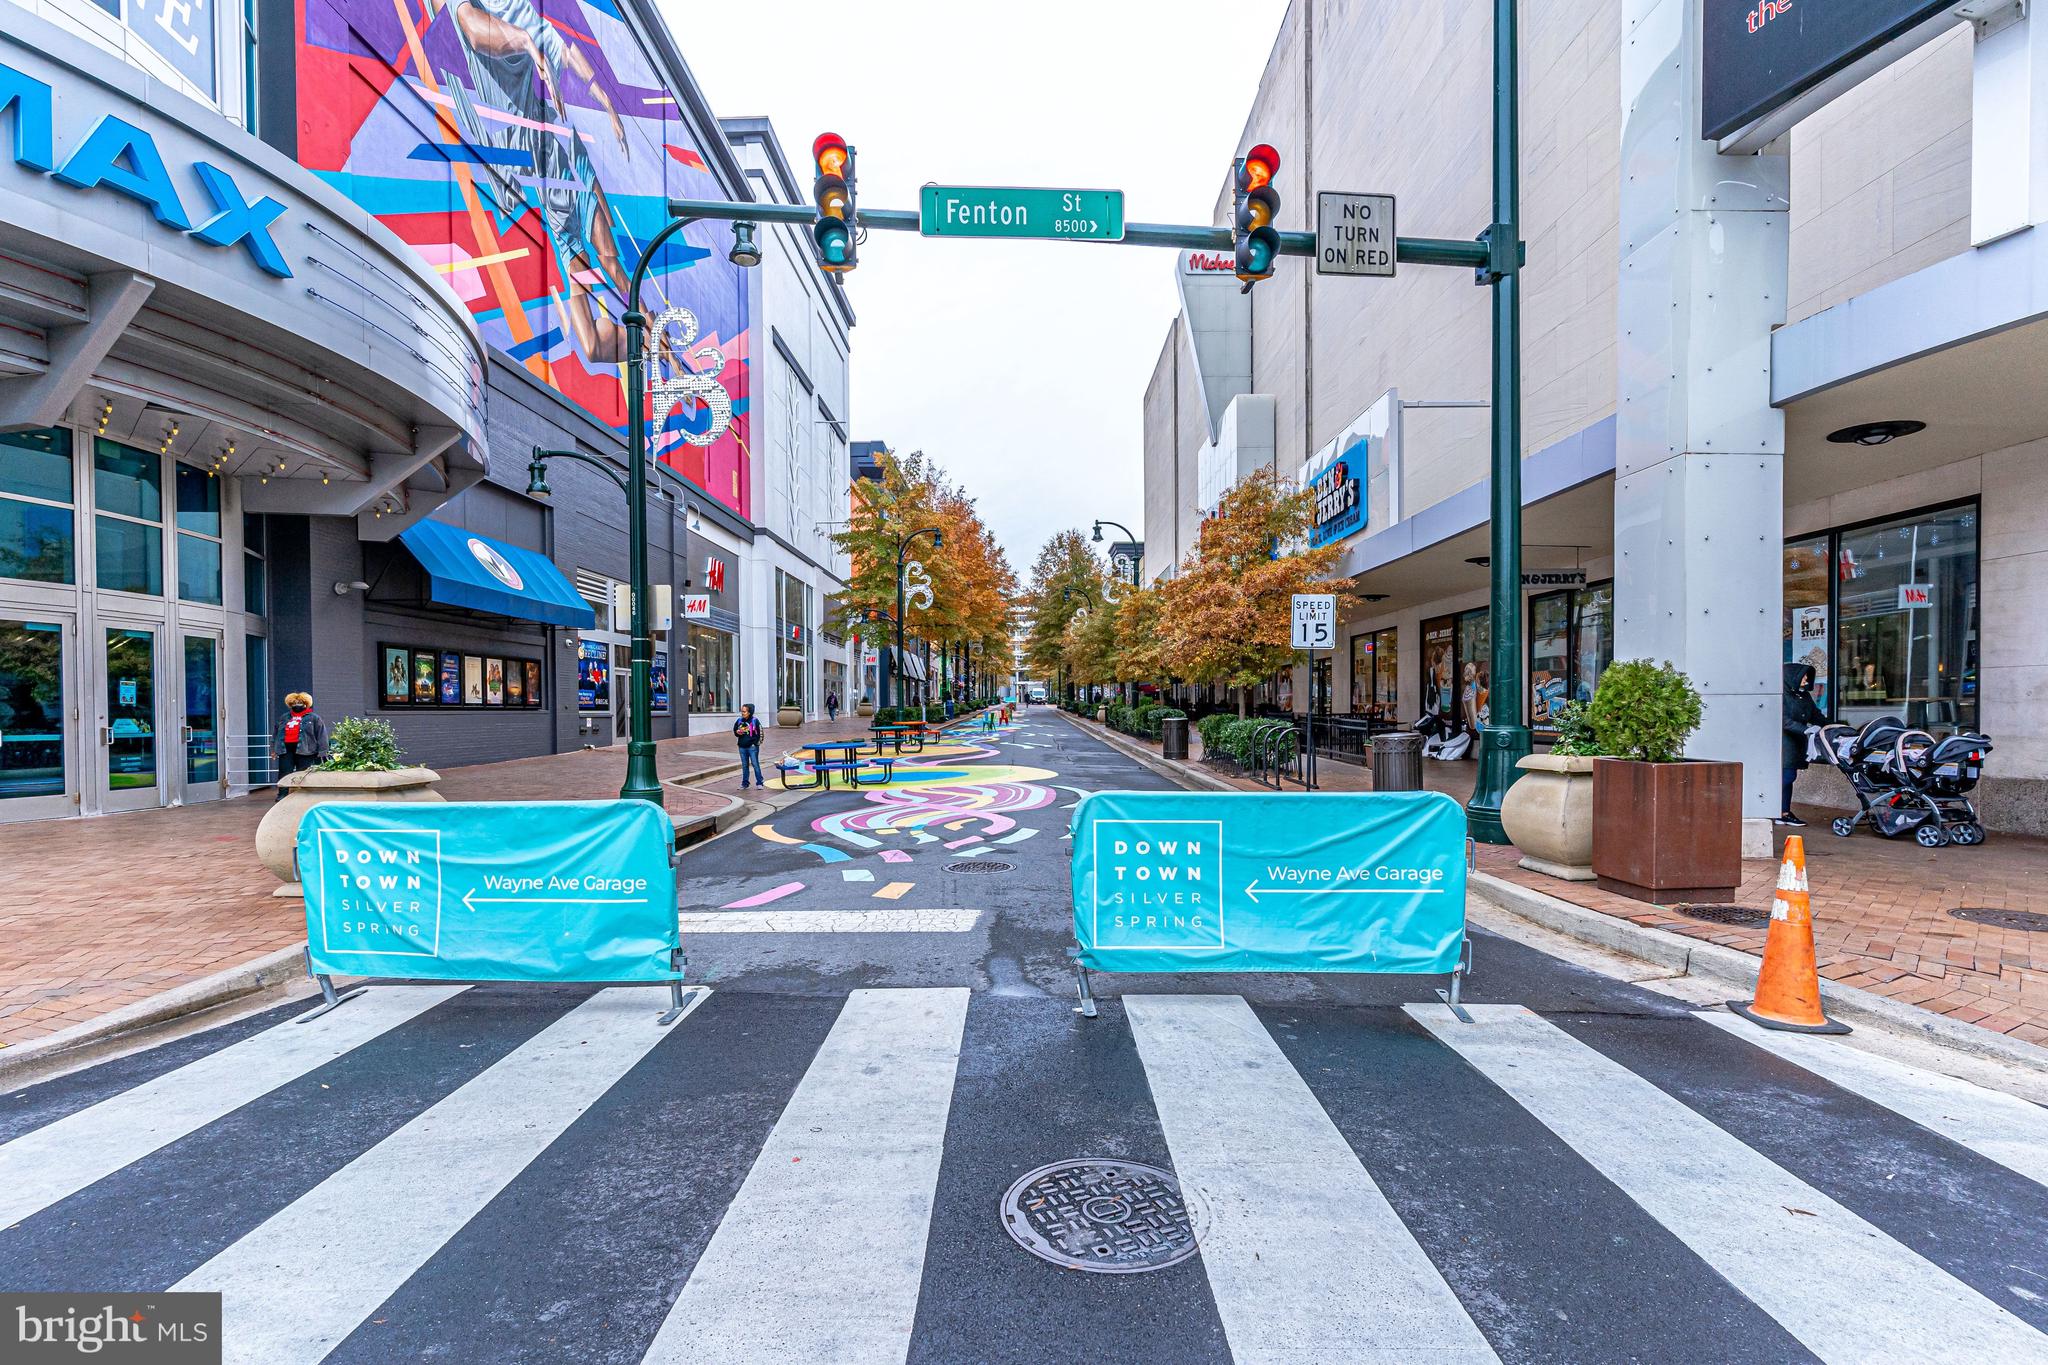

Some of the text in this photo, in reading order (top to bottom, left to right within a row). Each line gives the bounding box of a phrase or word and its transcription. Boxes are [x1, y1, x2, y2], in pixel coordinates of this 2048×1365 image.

[1745, 0, 1793, 34] the
[946, 193, 1082, 225] Fenton St
[1343, 203, 1371, 220] NO
[1055, 219, 1087, 233] 8500
[1333, 225, 1379, 243] TURN
[1189, 253, 1235, 271] Michae
[1324, 247, 1389, 266] ON RED
[1316, 478, 1355, 525] JERRY'S
[1295, 600, 1331, 610] SPEED
[1299, 612, 1327, 621] LIMIT
[1302, 623, 1328, 642] 15
[1801, 628, 1825, 638] STUFF
[336, 849, 421, 865] DOWN
[1114, 841, 1201, 856] DOWN
[1115, 866, 1201, 881] TOWN
[1267, 866, 1444, 885] Wayne Ave Garage
[340, 874, 421, 891] TOWN
[483, 875, 648, 894] Wayne Ave Garage
[342, 899, 421, 914] SILVER
[1115, 892, 1202, 905] SILVER
[343, 921, 420, 938] SPRING
[1115, 915, 1203, 929] SPRING
